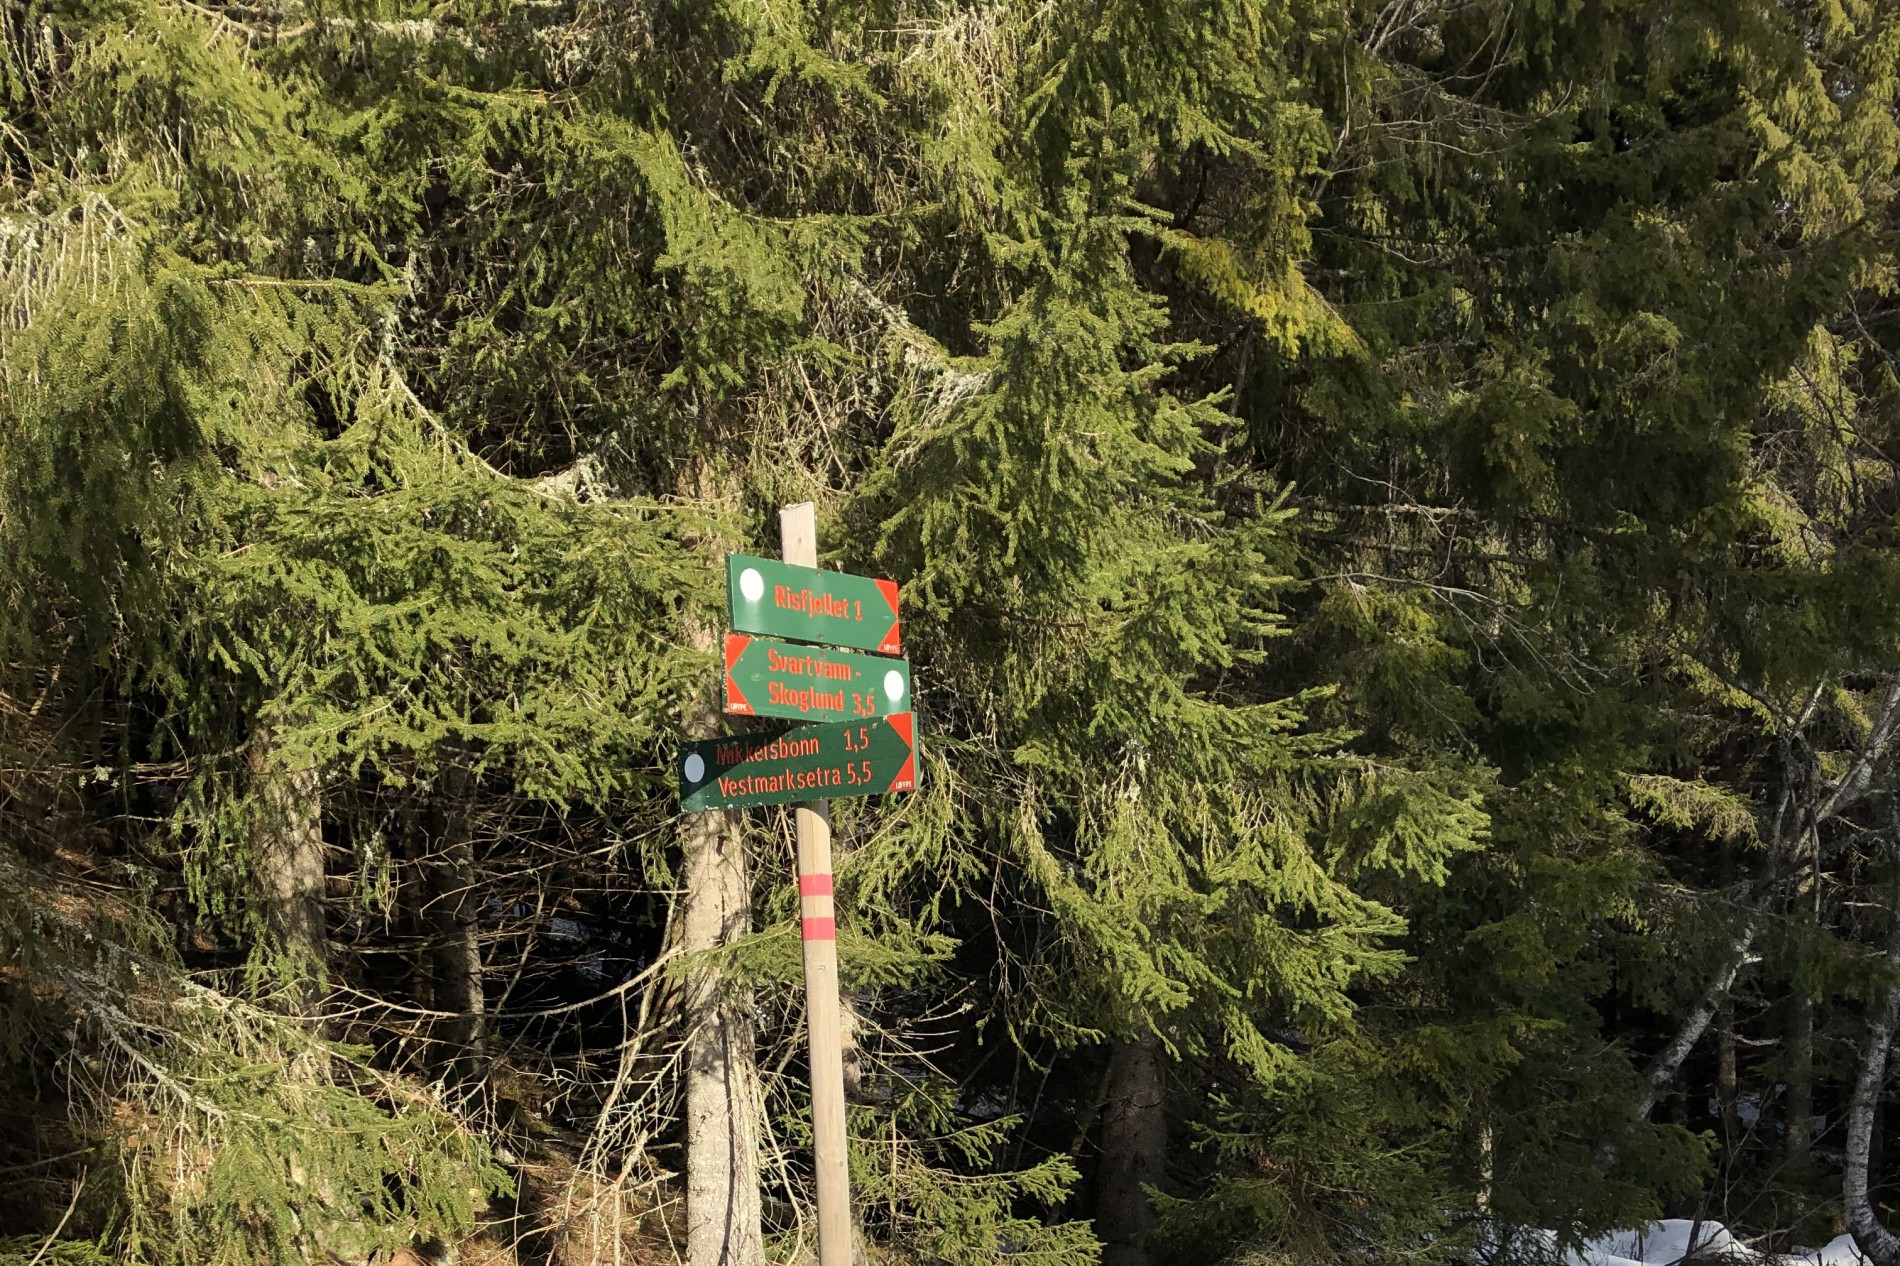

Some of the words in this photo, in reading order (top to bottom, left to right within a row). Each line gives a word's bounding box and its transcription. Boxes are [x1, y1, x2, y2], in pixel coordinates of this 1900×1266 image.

[774, 585, 849, 618] Risfjellet
[854, 601, 863, 621] 1
[768, 649, 852, 681] Svartvann
[768, 682, 844, 712] Skoglund
[852, 693, 876, 717] 3,5
[716, 737, 819, 765] Mikkelsbonn
[844, 728, 869, 752] 1,5
[718, 768, 841, 798] Vestmarksetra
[847, 761, 872, 785] 5,5
